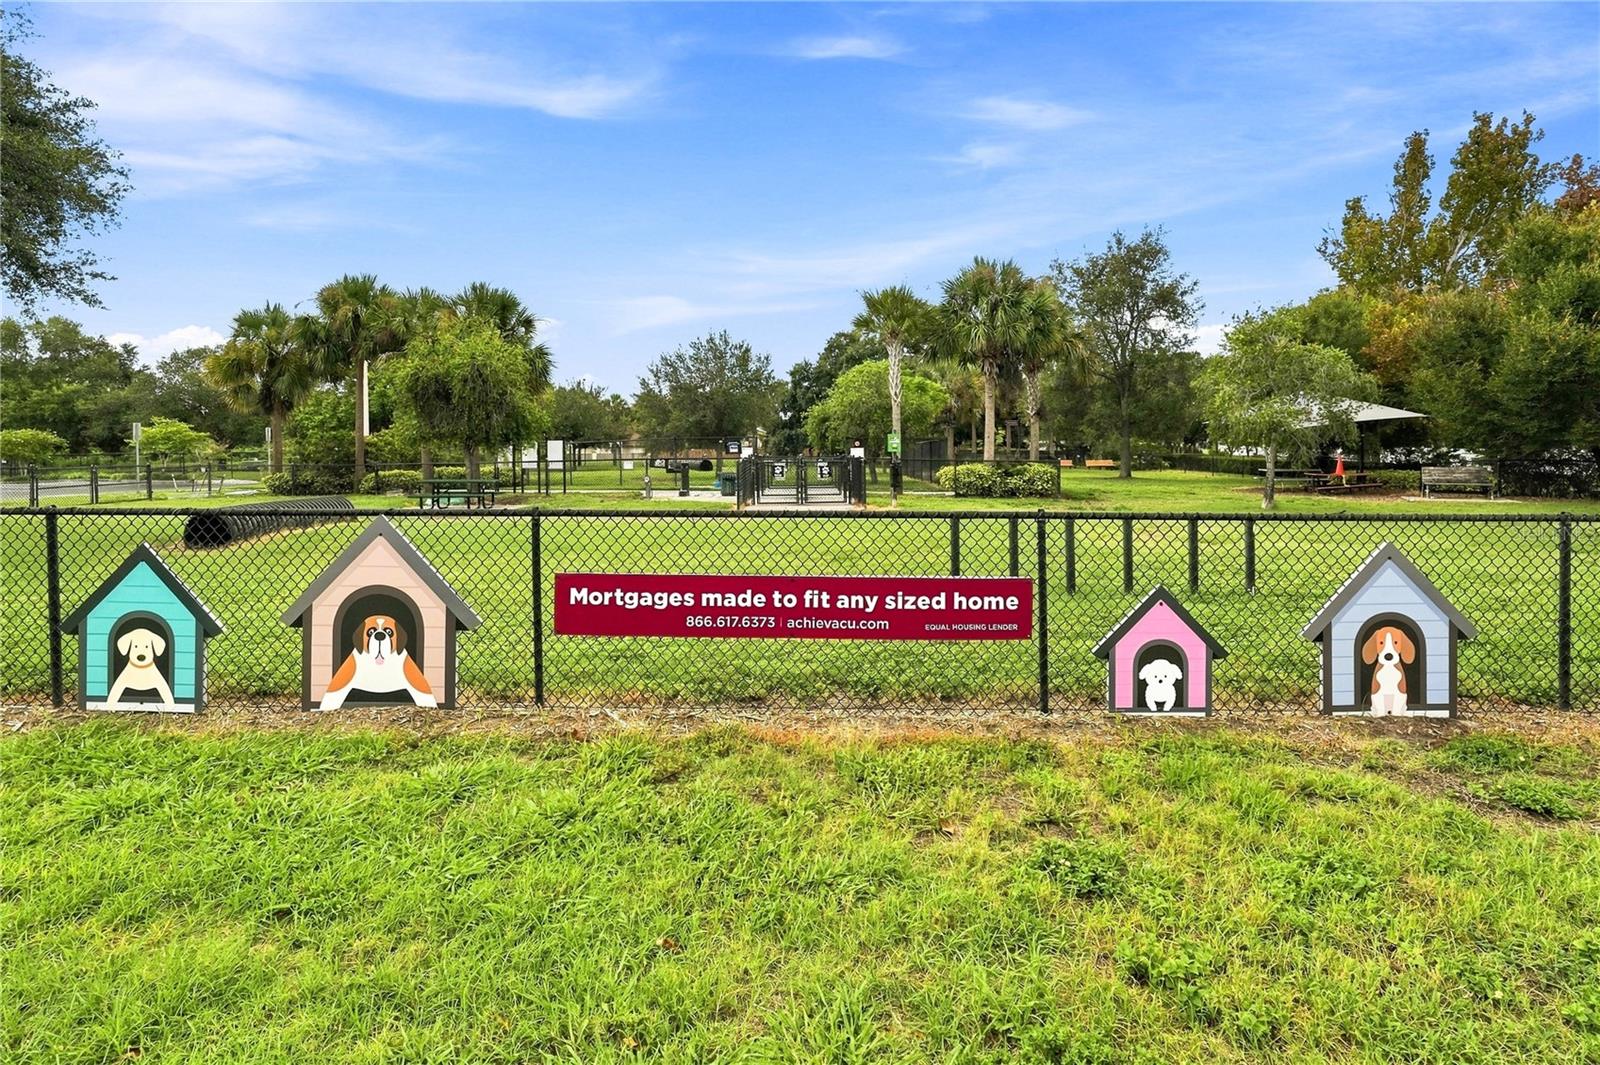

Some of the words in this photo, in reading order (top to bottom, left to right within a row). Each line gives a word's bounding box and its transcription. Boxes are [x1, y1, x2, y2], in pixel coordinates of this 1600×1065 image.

[569, 587, 695, 609] Mortgages
[701, 589, 767, 608] made
[772, 590, 797, 608] to
[803, 590, 831, 609] fit
[836, 594, 879, 613] any
[884, 591, 947, 610] sized
[953, 592, 1019, 610] home
[686, 616, 776, 628] 866.617.6373
[786, 616, 890, 630] achievacu.com
[925, 623, 950, 631] EQUAL
[952, 623, 986, 631] HOUSING
[988, 623, 1018, 631] LENDER
